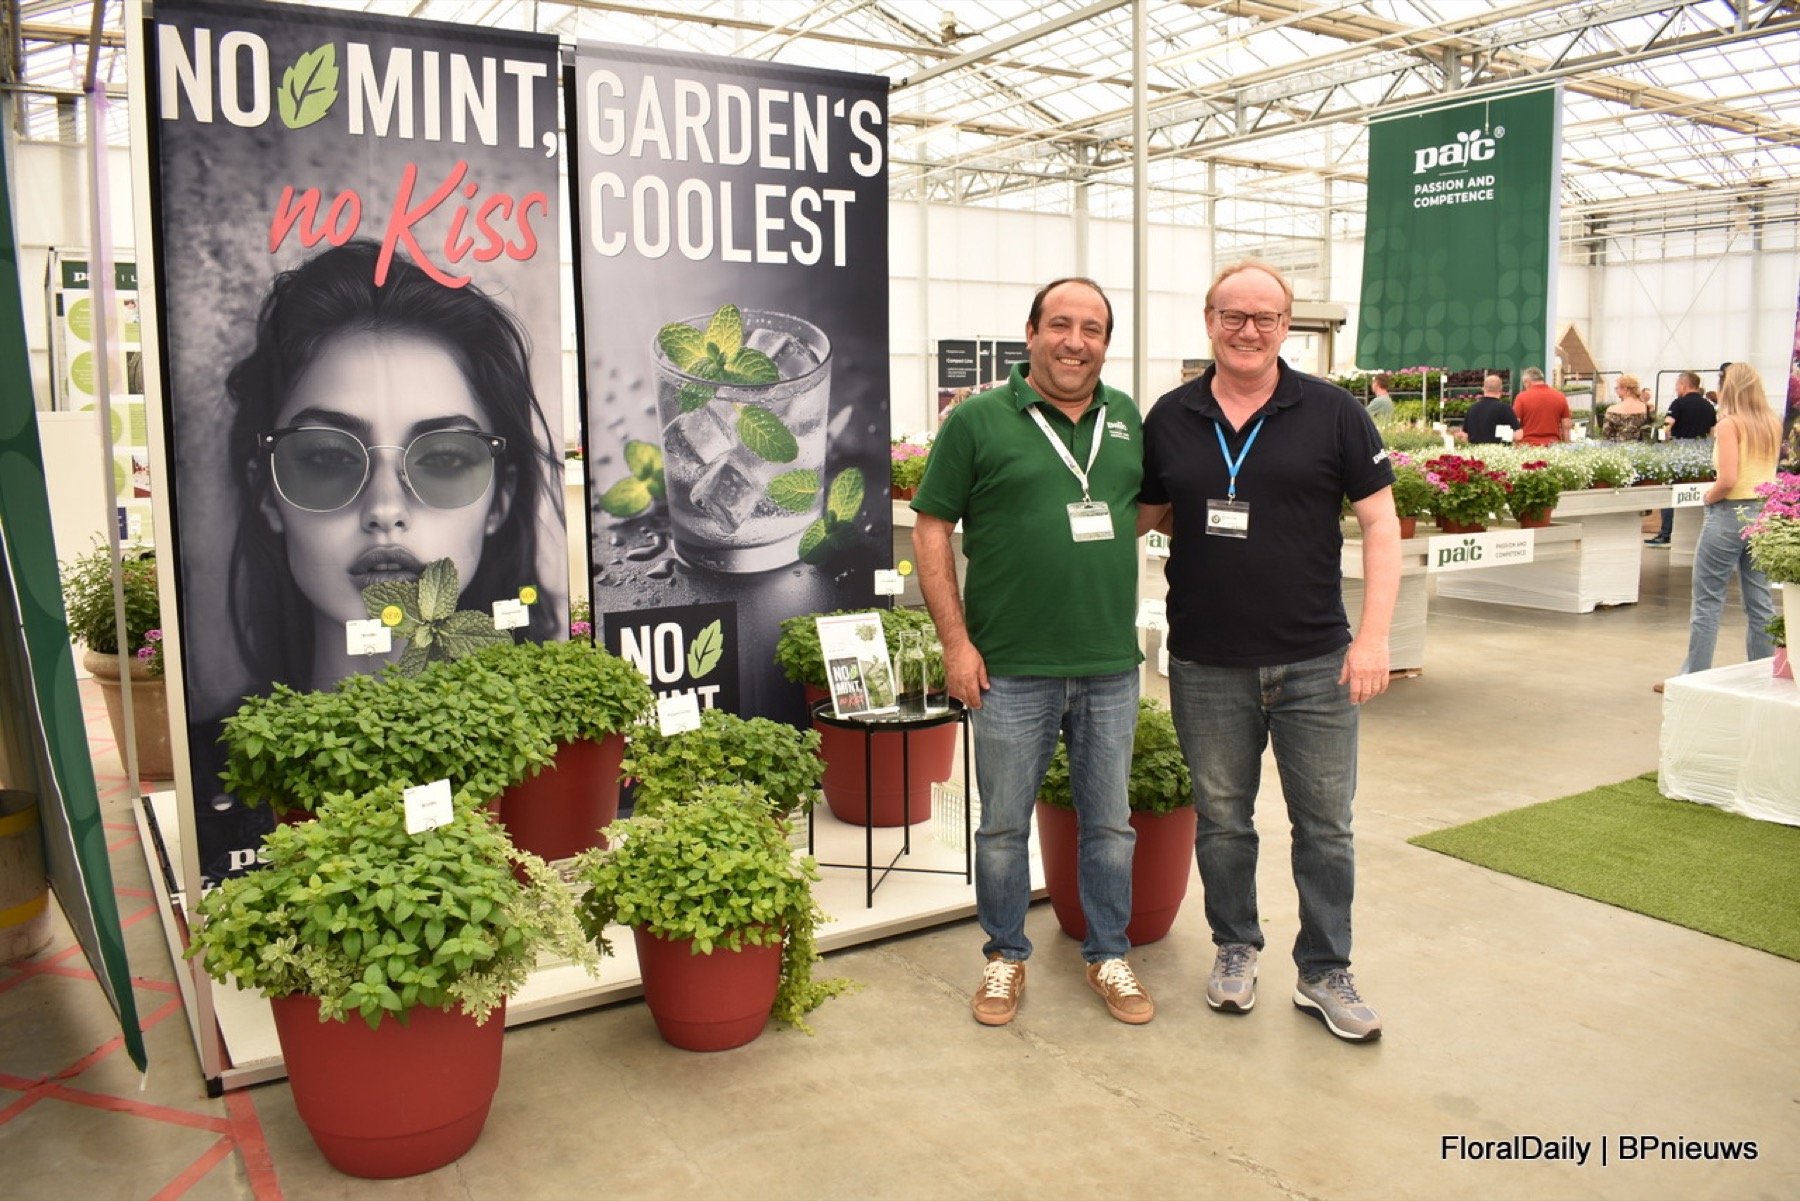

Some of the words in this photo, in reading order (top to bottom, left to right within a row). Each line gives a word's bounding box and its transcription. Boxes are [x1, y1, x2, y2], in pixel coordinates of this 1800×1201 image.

[157, 23, 271, 128] NO
[346, 41, 558, 158] MINT,
[1414, 178, 1464, 195] PASSION
[1467, 175, 1496, 188] AND
[1413, 189, 1495, 208] COMPETENCE
[270, 185, 362, 255] no
[373, 160, 548, 289] Kiss
[590, 171, 856, 267] COOLEST
[383, 610, 402, 620] NEW
[833, 665, 850, 682] NO
